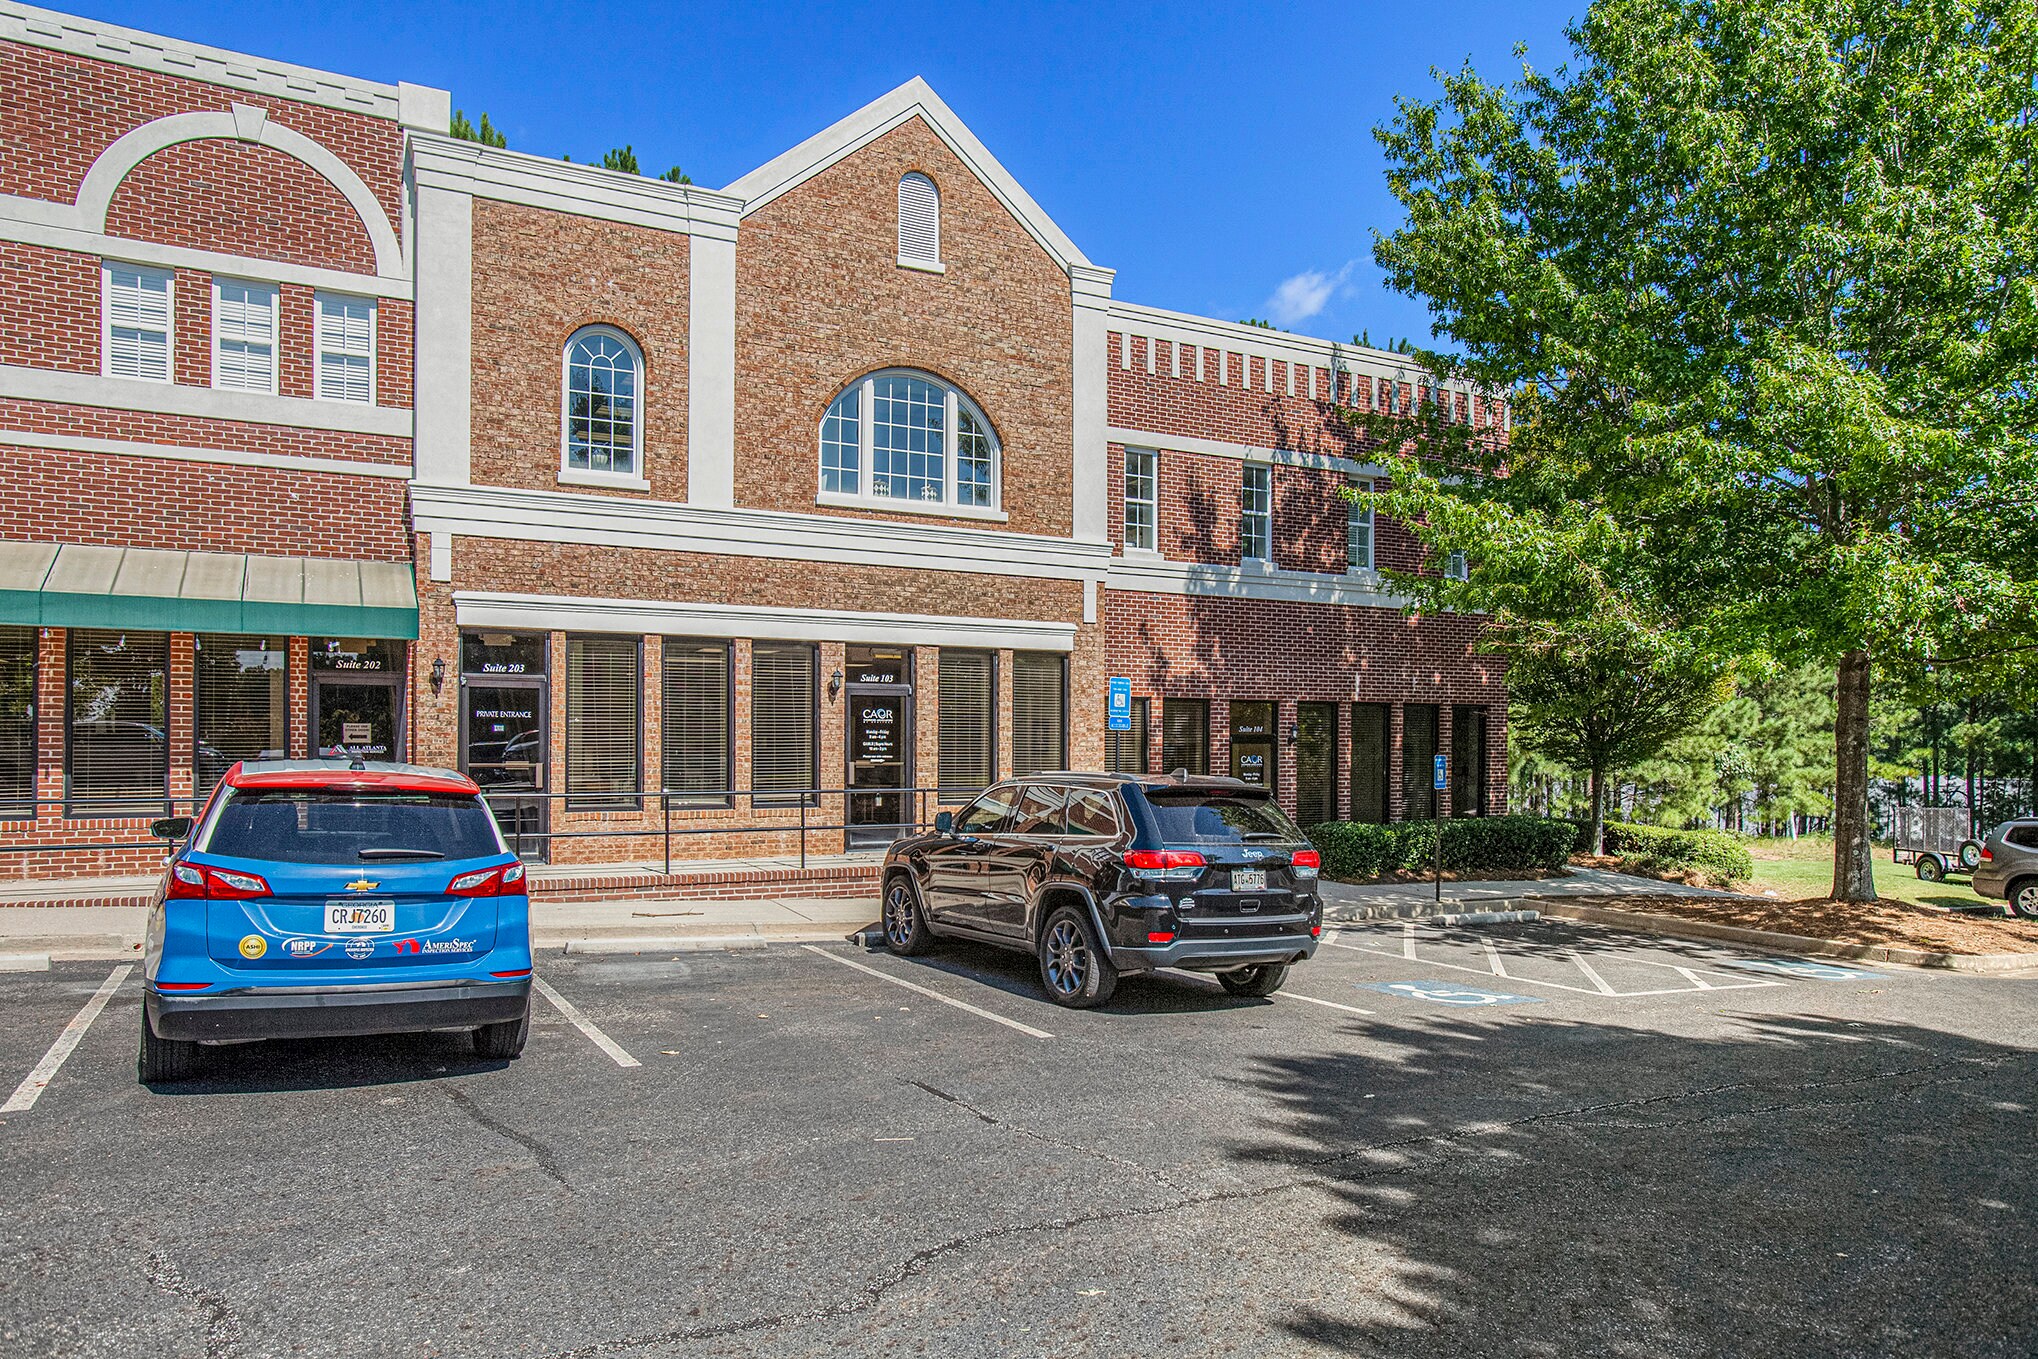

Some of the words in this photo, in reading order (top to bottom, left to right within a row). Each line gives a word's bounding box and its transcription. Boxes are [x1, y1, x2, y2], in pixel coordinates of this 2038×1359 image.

[335, 660, 361, 669] Suite
[363, 661, 381, 670] 202
[483, 664, 507, 672] Suite
[508, 664, 525, 673] 203
[860, 674, 880, 682] Suite
[880, 674, 894, 683] 103
[476, 710, 499, 718] PRIVATE
[1238, 725, 1253, 733] Suite
[1241, 849, 1264, 860] Jeep
[332, 908, 387, 924] CRJ7260
[291, 941, 316, 951] NRPP
